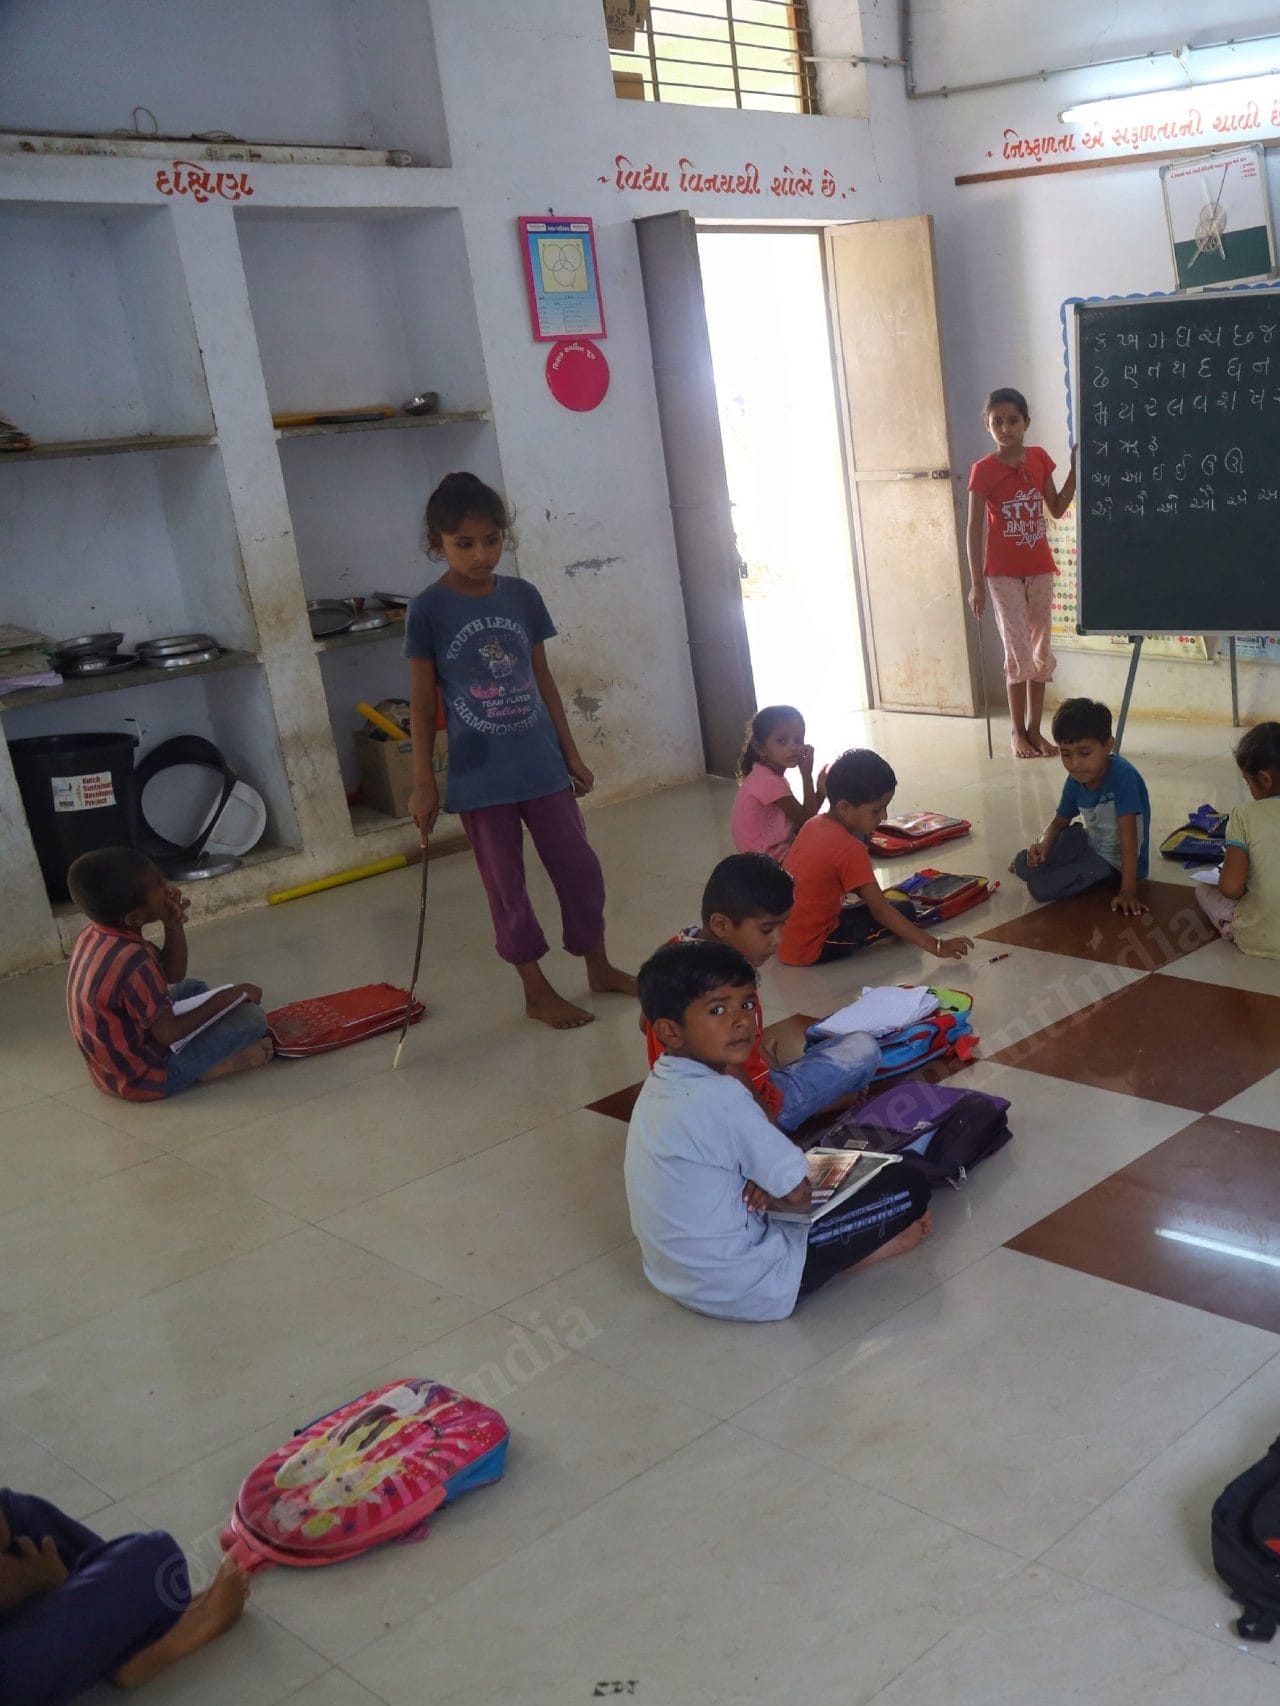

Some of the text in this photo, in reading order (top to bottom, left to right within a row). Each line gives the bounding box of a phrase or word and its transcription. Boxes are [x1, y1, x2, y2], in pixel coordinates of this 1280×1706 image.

[156, 160, 254, 203] દક્ષિણ
[678, 158, 760, 194] વિનયથી
[770, 165, 814, 197] શોભે
[1148, 330, 1165, 349] ગ
[1198, 326, 1221, 347] ચ
[446, 619, 484, 661] YOUTH
[481, 699, 504, 708] TEAM
